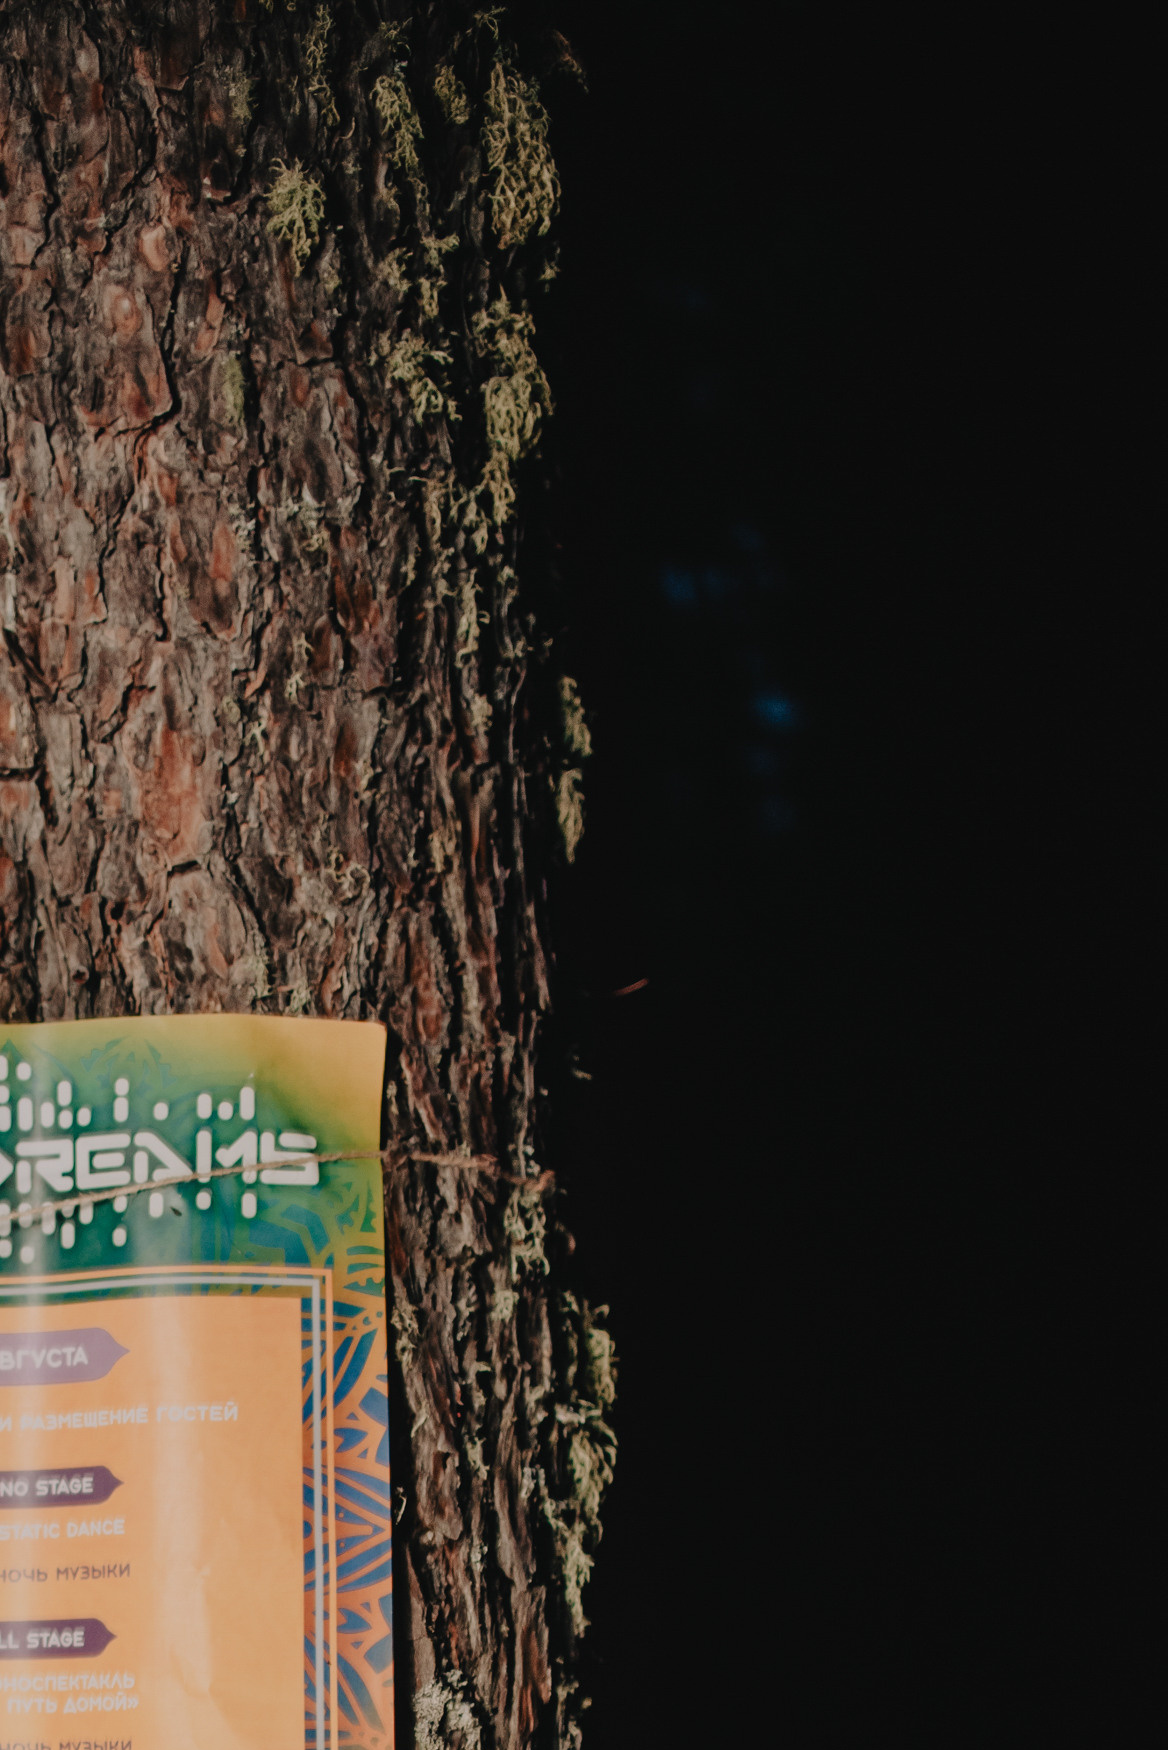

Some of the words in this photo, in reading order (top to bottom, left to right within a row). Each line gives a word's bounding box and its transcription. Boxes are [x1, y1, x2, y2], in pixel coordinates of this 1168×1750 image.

[20, 1408, 148, 1431] РАЗМЕЩЕНИЕ
[156, 1401, 239, 1424] ГОСТЕЙ
[35, 1477, 94, 1496] STAGE
[67, 1519, 126, 1538] DANCE
[56, 1564, 131, 1581] МУЗЫКИ
[27, 1630, 85, 1648] STAGE
[7, 1697, 57, 1714] ПУТЬ
[63, 1693, 139, 1715] ДОМОЙ»
